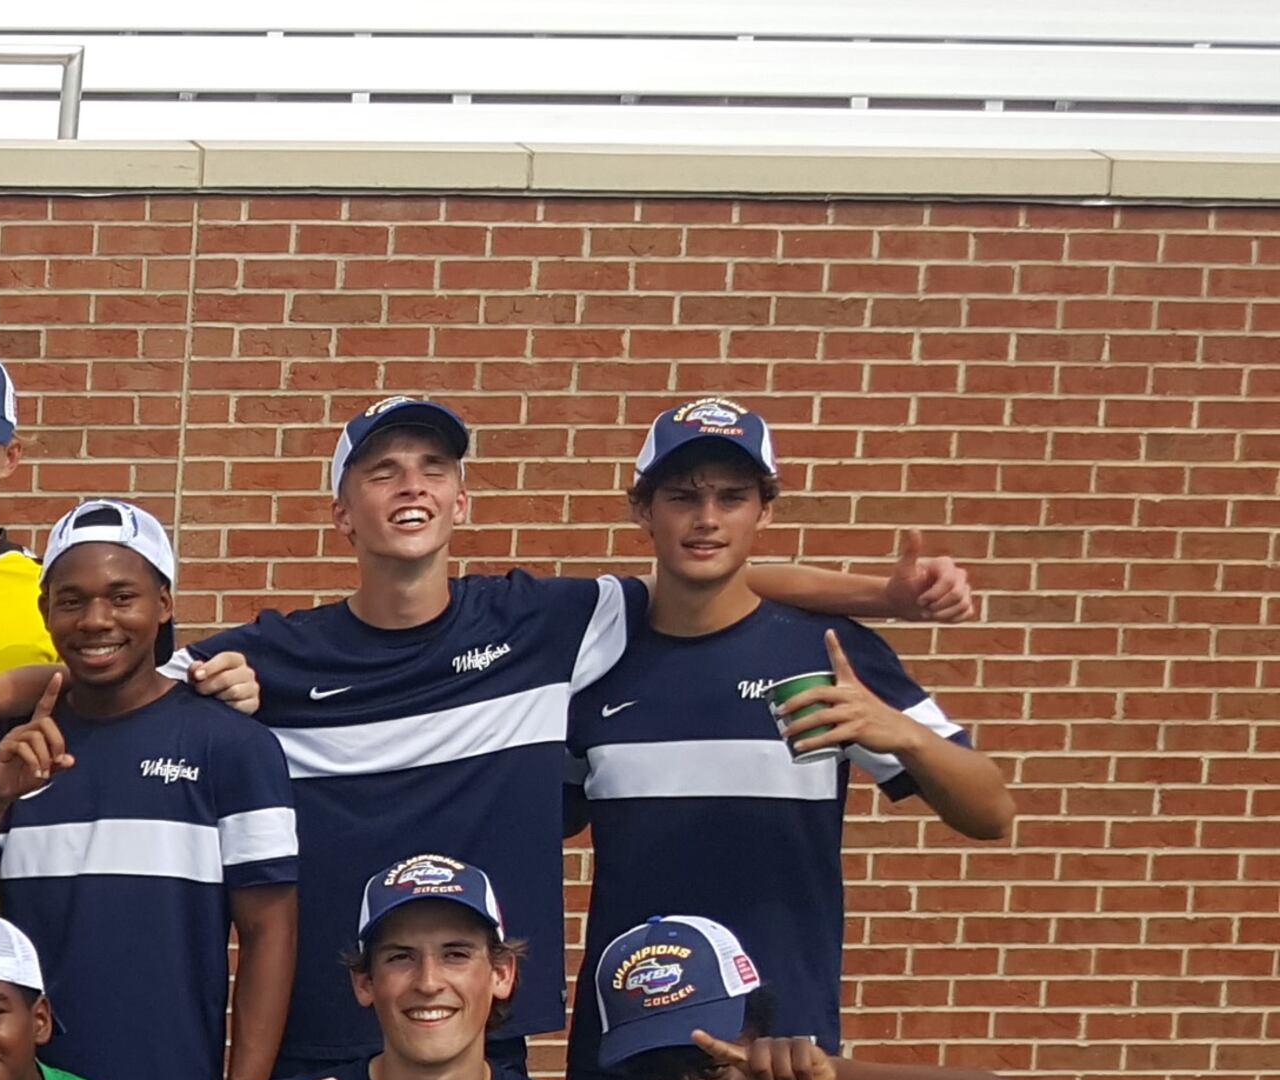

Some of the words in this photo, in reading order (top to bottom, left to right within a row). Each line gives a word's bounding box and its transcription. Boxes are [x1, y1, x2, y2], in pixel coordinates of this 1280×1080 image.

[453, 643, 511, 673] Whitefield
[141, 758, 199, 784] Whitefield
[385, 854, 464, 885] CHAMPIONS
[413, 885, 464, 893] SOCCER
[613, 945, 692, 990] CHAMPIONS
[629, 964, 681, 985] GHSA
[644, 985, 696, 1007] SOCCER
